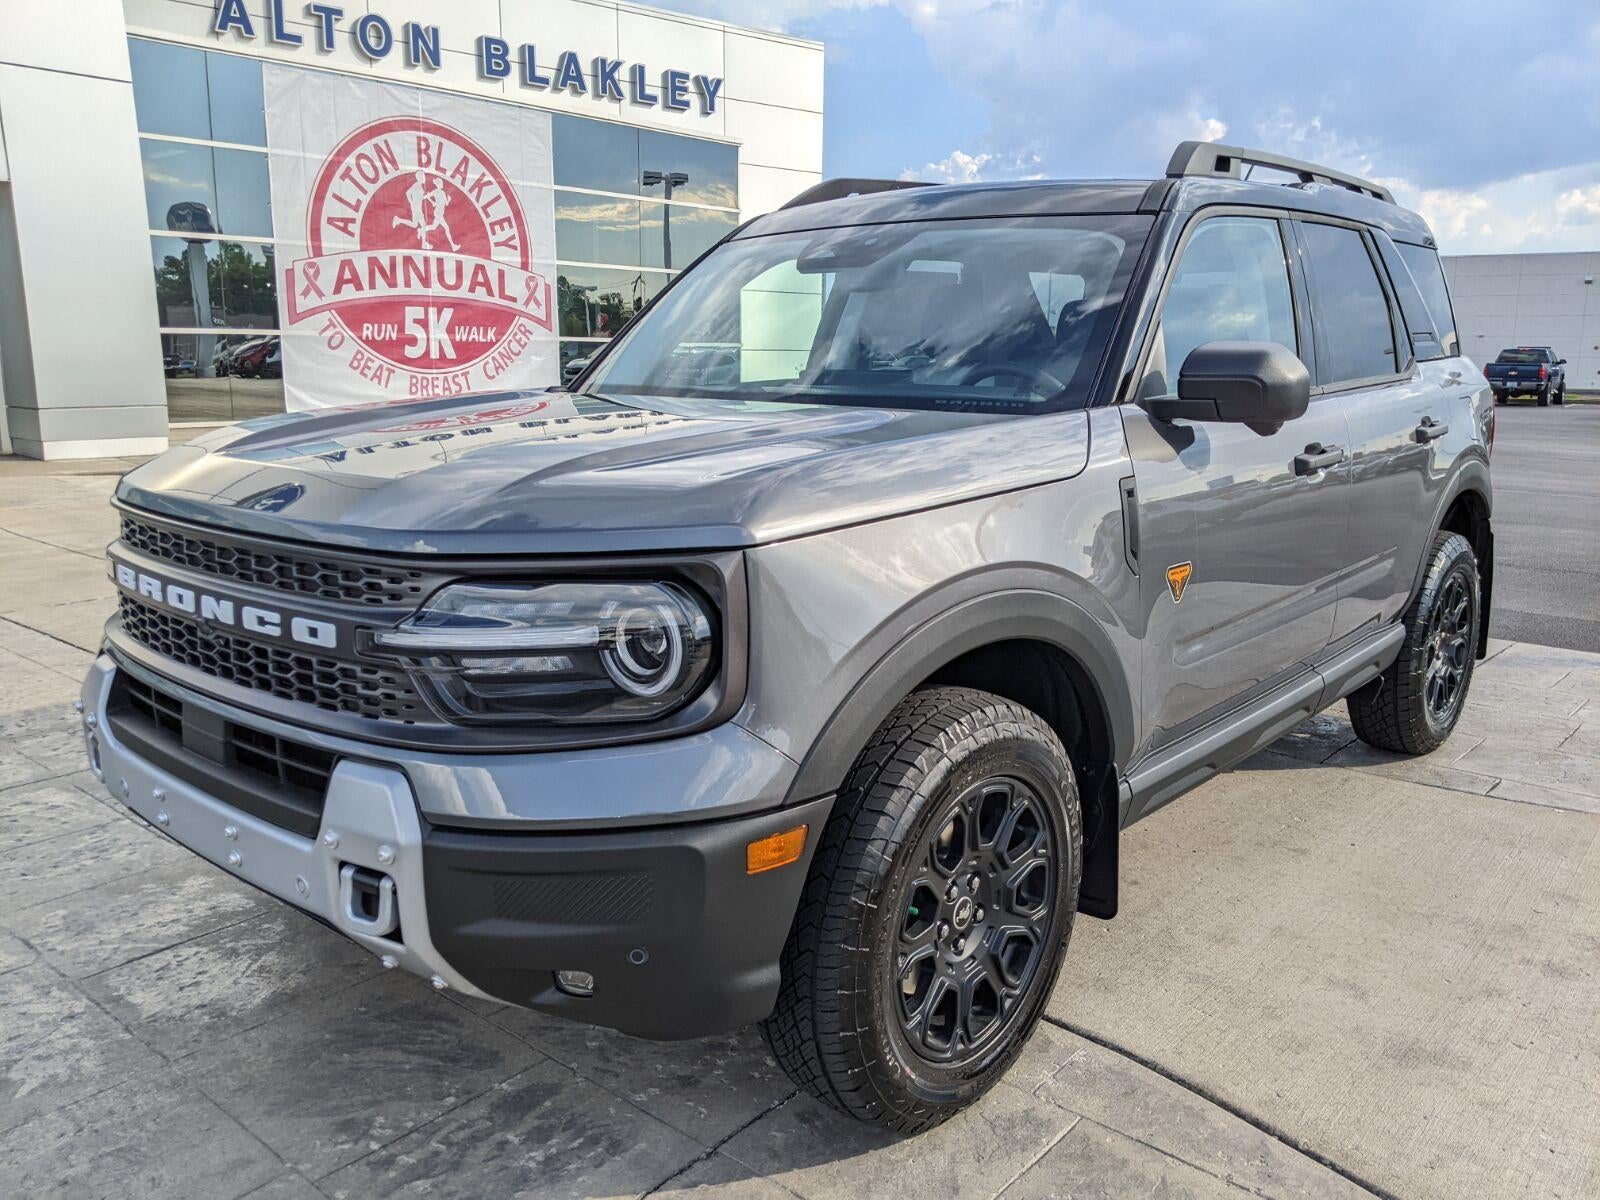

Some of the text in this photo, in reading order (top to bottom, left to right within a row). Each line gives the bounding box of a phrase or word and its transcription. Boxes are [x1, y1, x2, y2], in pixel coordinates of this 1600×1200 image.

[215, 0, 724, 116] ALTON BLAKLEY
[327, 136, 518, 251] ALTON BLAKLEY
[333, 255, 518, 303] ANNUAL
[318, 318, 533, 397] TO BEAT BREAST CANCER
[362, 306, 496, 359] RUN 5K WALK
[116, 564, 337, 648] BRONCO
